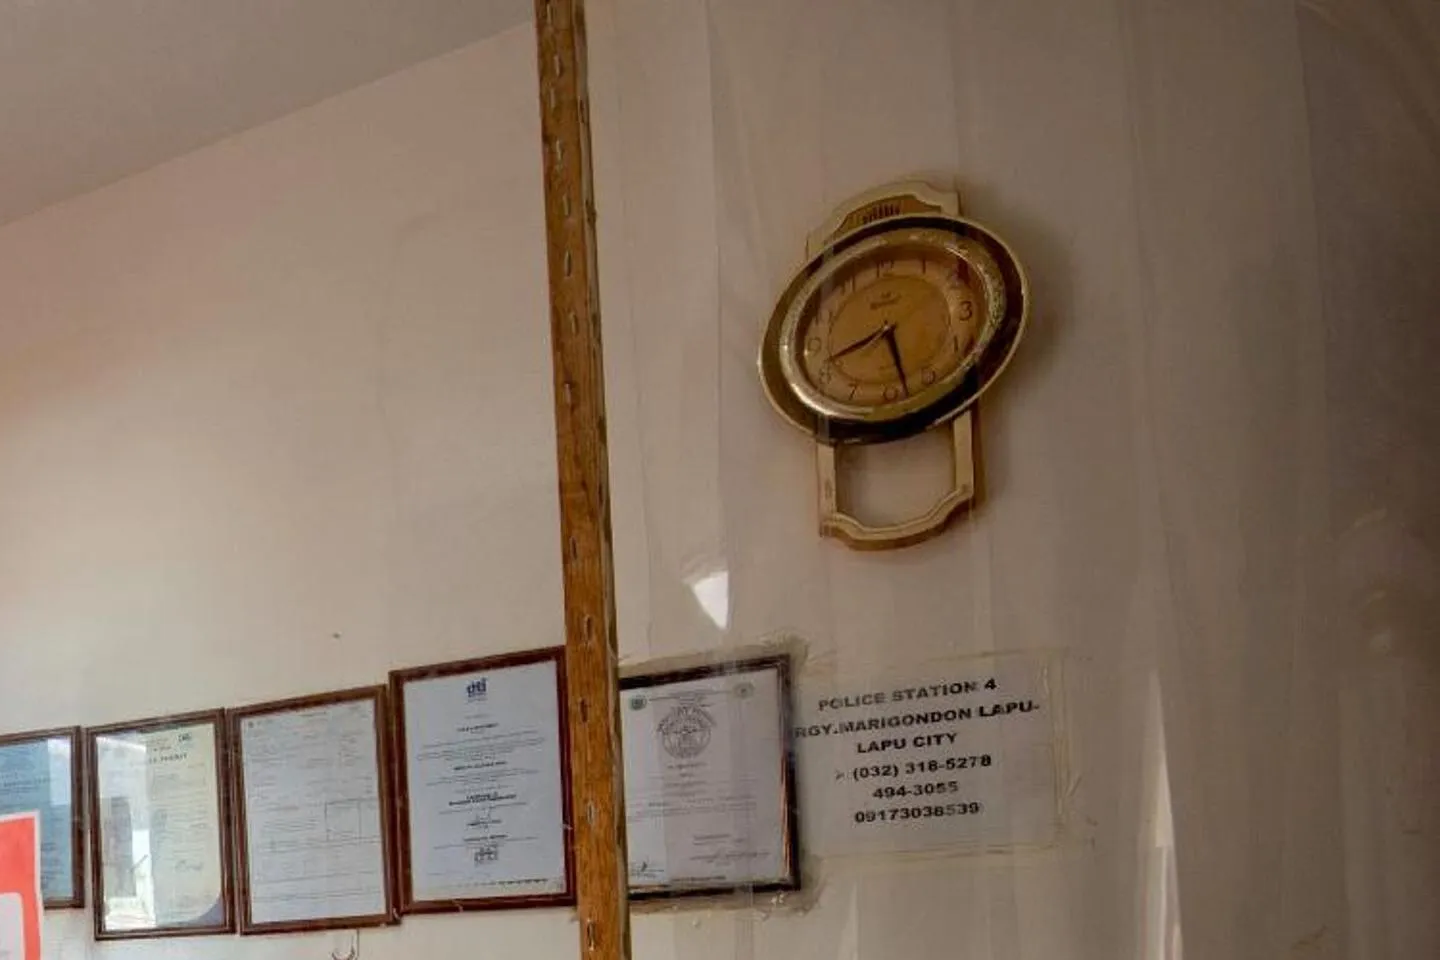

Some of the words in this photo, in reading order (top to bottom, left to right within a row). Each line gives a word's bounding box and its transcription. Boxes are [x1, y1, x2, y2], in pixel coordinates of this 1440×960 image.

[818, 693, 886, 711] POLICE
[892, 681, 979, 702] STATION
[984, 678, 997, 691] 4
[794, 707, 973, 739] RGY.MARIGONDON
[857, 738, 907, 754] LAPU
[913, 733, 958, 748] CITY
[853, 764, 900, 781] (032)
[905, 754, 993, 775] 318-5278
[872, 780, 960, 800] 494-3055
[854, 802, 981, 823] 09173038539
